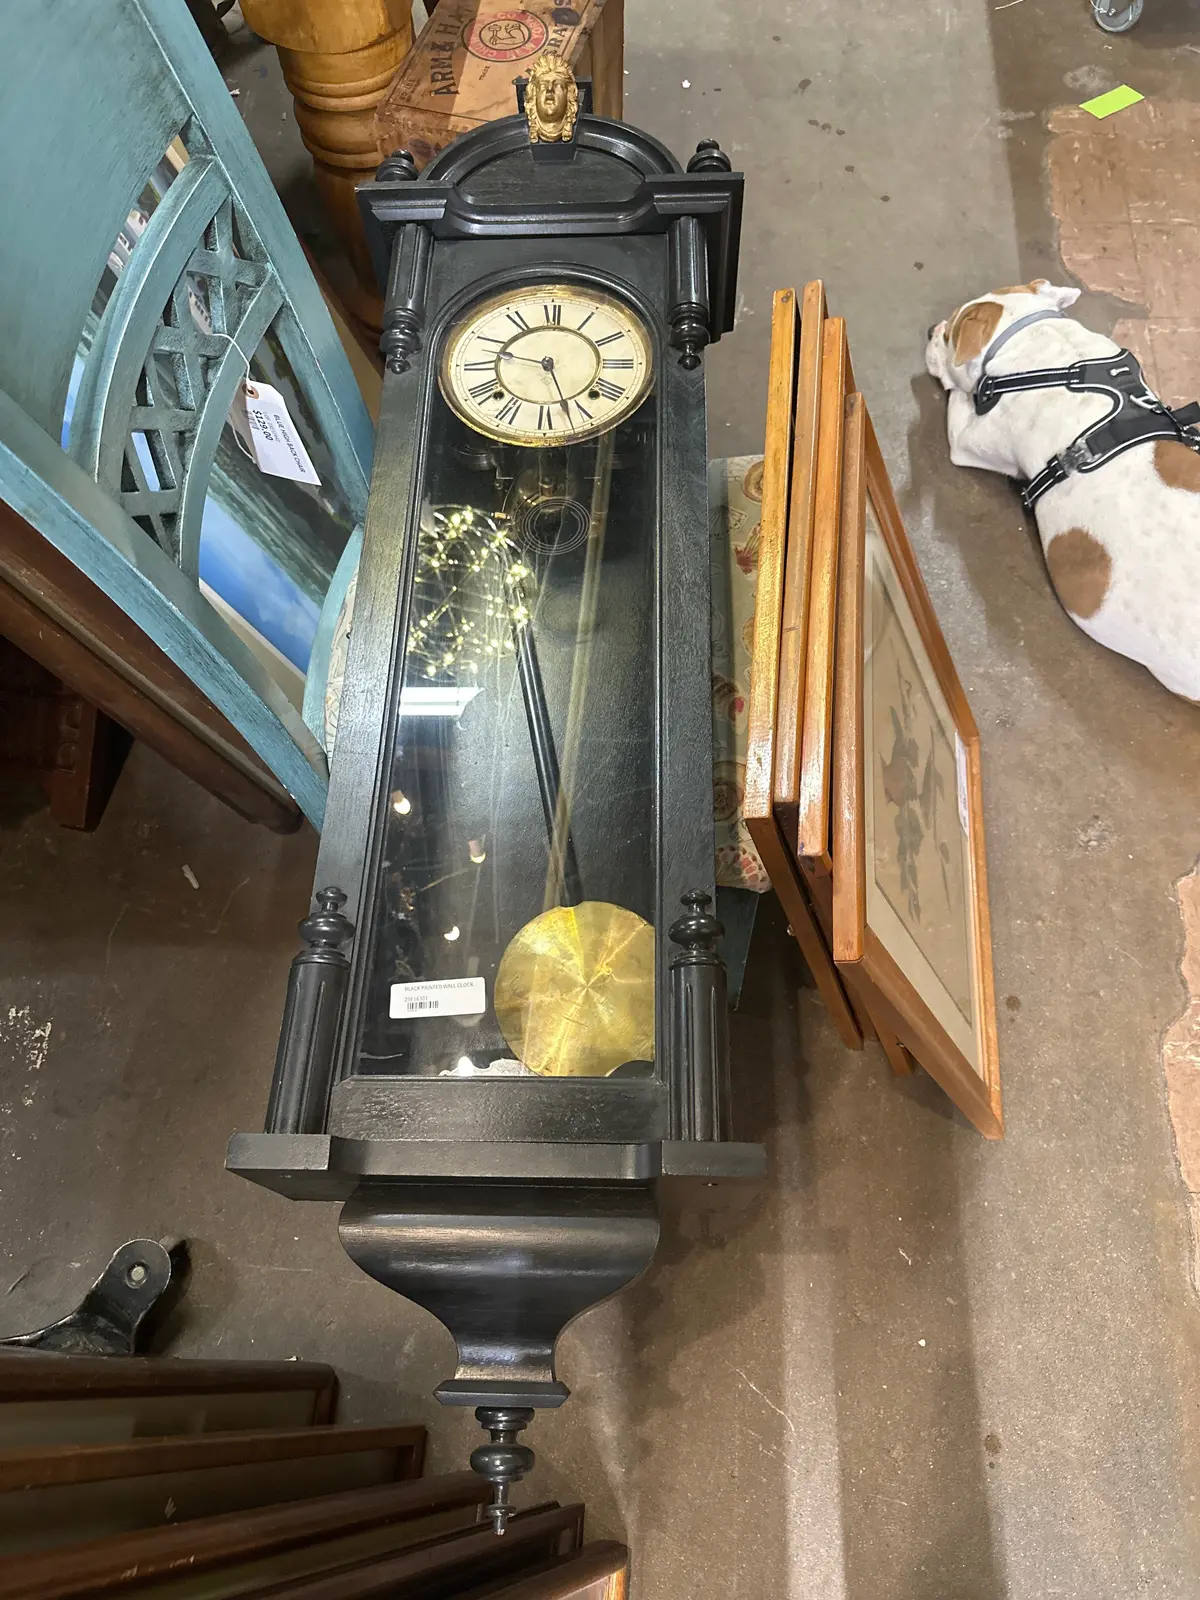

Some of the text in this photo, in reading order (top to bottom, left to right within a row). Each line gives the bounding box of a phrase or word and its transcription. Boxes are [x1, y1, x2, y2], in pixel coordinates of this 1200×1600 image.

[430, 41, 456, 53] &
[429, 55, 460, 96] ARM
[252, 409, 274, 441] $129.00
[280, 428, 292, 443] HIGH
[286, 441, 299, 457] BACK
[294, 456, 306, 473] CHAIR
